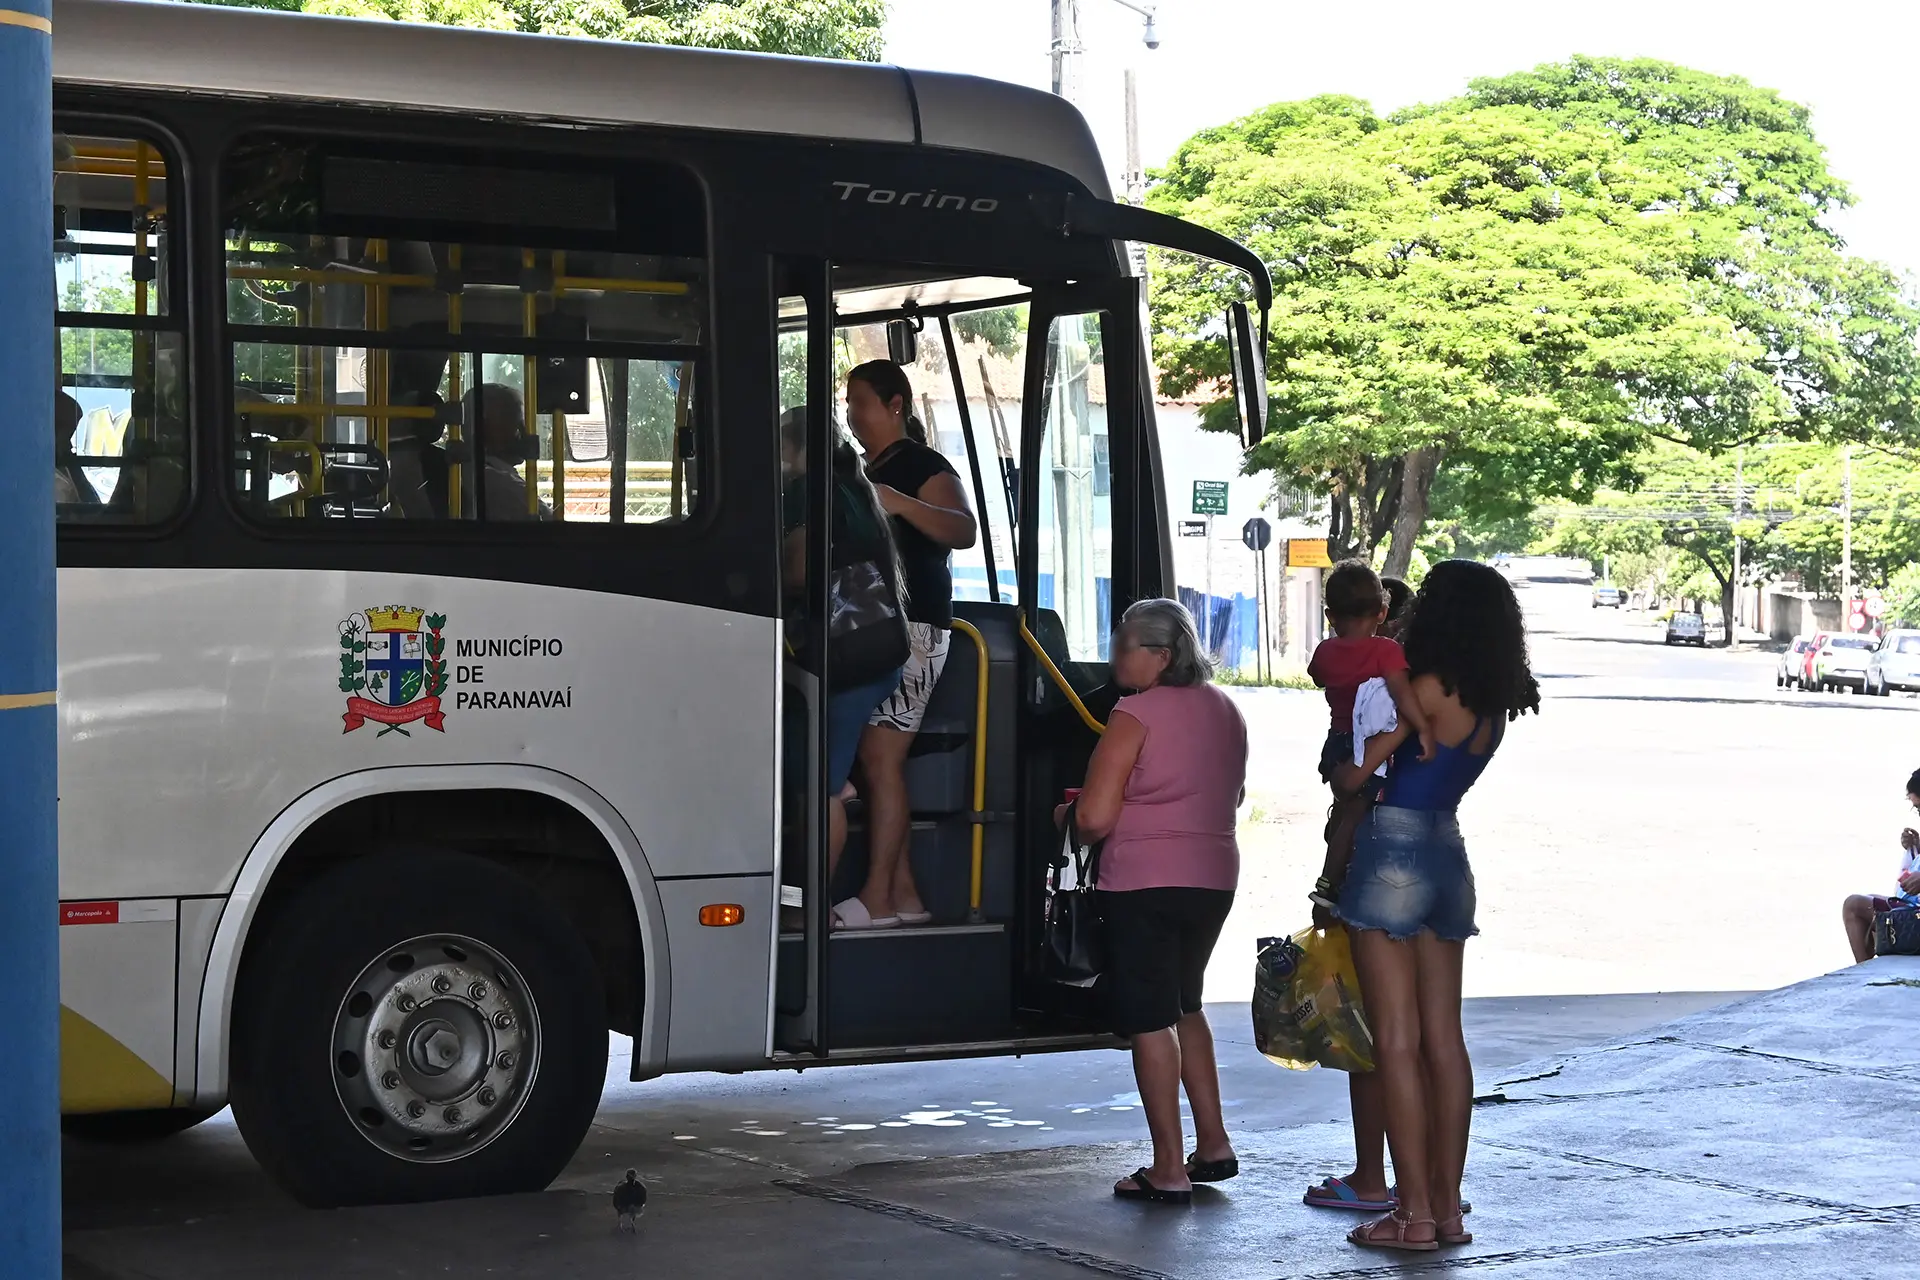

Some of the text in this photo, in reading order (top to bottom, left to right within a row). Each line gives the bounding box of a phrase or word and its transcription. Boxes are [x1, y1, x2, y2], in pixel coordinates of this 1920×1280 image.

[832, 180, 998, 212] Torino
[456, 635, 562, 657] MUNICÍPIO
[456, 665, 484, 684] DE
[456, 686, 571, 709] PARANAVAÍ
